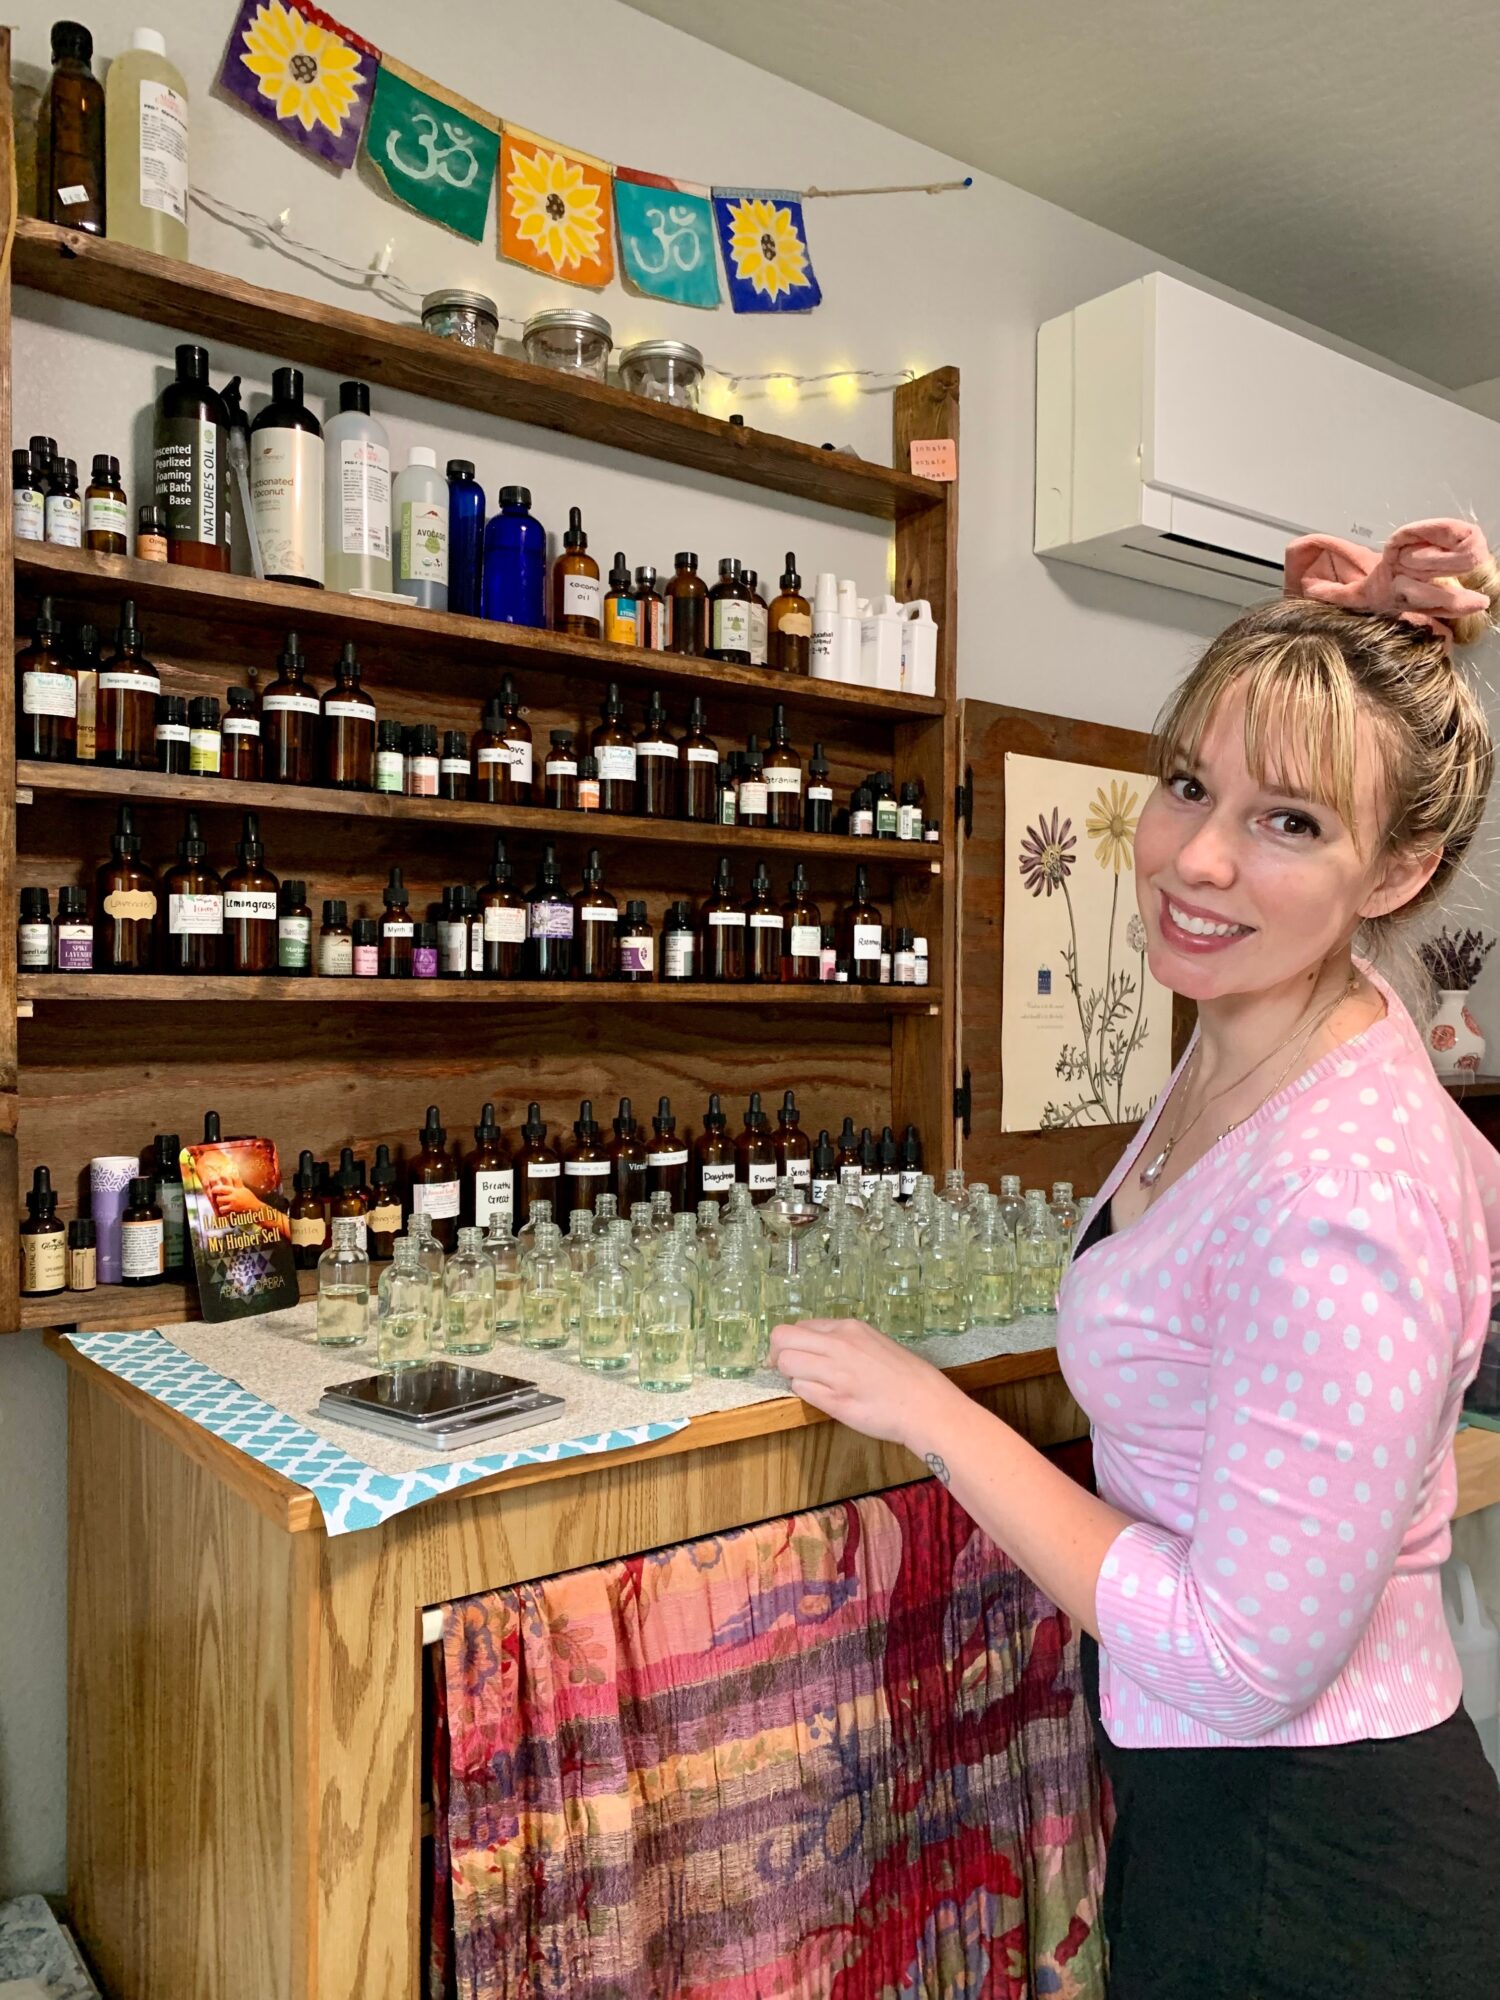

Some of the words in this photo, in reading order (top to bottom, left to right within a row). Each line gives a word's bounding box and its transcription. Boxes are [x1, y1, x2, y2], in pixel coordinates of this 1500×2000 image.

[155, 457, 192, 469] Pearlized
[203, 448, 215, 472] OIL
[156, 469, 192, 482] Foaming
[169, 482, 192, 493] Bath
[169, 495, 192, 506] Base
[203, 472, 215, 537] NATURE'S
[401, 511, 411, 527] OIL
[401, 529, 411, 572] CARRIER
[225, 897, 276, 913] Lemongrass
[387, 926, 406, 934] Myrrh
[487, 1195, 510, 1204] Great
[210, 1214, 228, 1230] Am
[228, 1209, 266, 1227] Guided
[266, 1206, 278, 1222] by
[208, 1235, 224, 1253] My
[225, 1232, 261, 1250] Higher
[261, 1227, 281, 1244] Self
